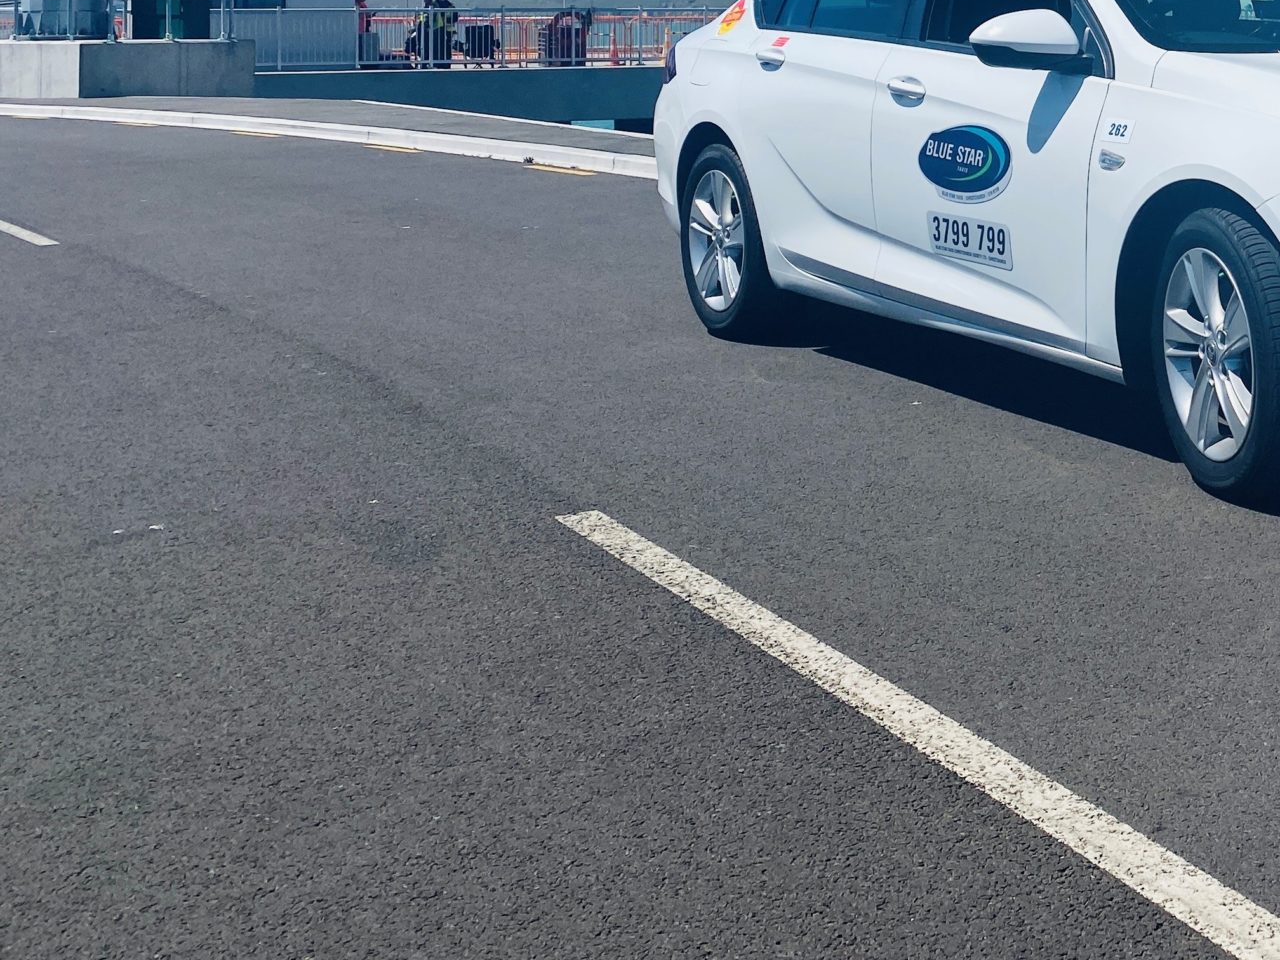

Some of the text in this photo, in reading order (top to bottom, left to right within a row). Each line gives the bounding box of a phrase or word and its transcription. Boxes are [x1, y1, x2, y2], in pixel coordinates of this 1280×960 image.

[1108, 123, 1128, 138] 262
[926, 139, 984, 167] BLUE STAR
[932, 215, 970, 248] 3799
[976, 223, 1006, 256] 799
